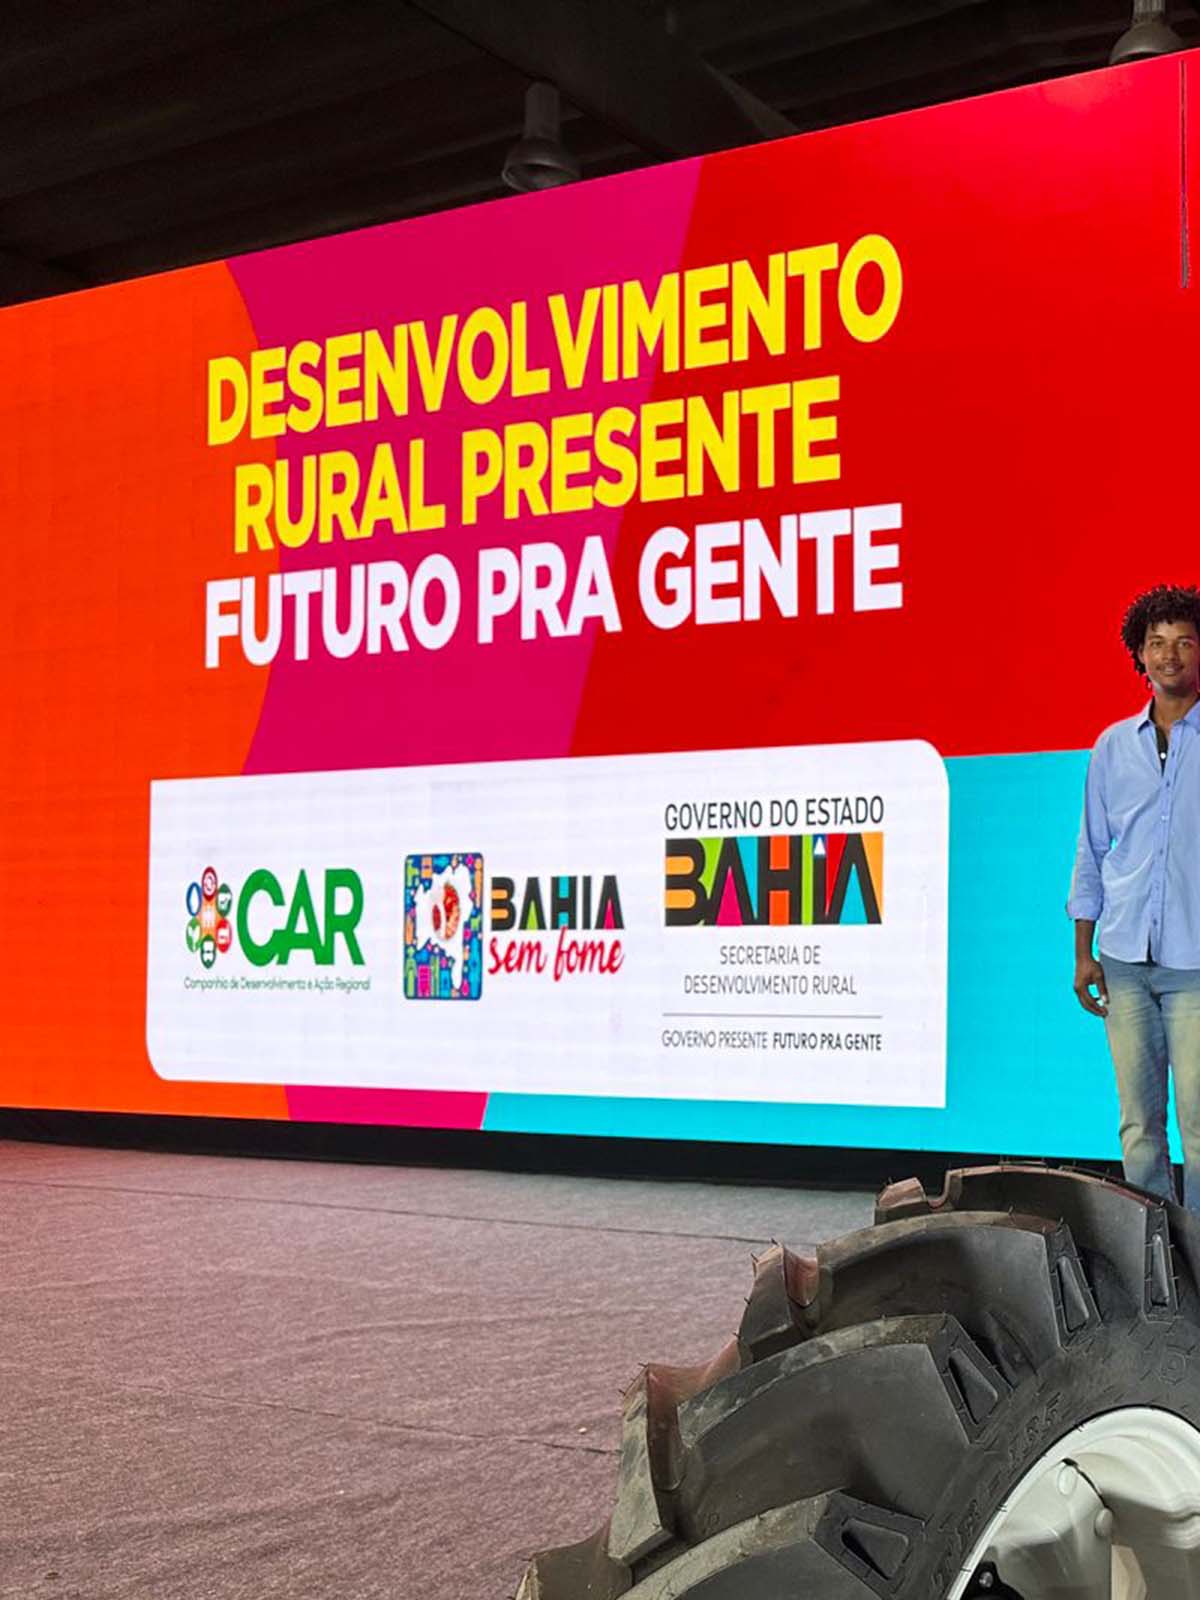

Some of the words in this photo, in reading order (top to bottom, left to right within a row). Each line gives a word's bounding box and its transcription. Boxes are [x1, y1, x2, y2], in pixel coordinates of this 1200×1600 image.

[207, 234, 903, 446] DESENVOLVIMENTO
[234, 439, 446, 553] RURAL
[462, 375, 841, 525] PRESENTE
[205, 553, 461, 669] FUTURO
[478, 535, 622, 644] PRA
[638, 503, 903, 629] GENTE
[664, 800, 763, 832] GOVERNO
[769, 799, 799, 827] DO
[805, 795, 885, 826] ESTADO
[490, 875, 625, 931] BAHIA
[665, 831, 884, 927] BAHIA
[236, 868, 366, 967] CAR
[488, 936, 547, 975] sem
[552, 926, 624, 982] fome
[719, 945, 800, 966] SECRETARIA
[803, 945, 821, 966] DE
[684, 974, 809, 995] DESENVOLVIMENTO
[812, 975, 858, 996] RURAL
[661, 1029, 717, 1048] GOVERNO
[718, 1030, 768, 1050] PRESENTE
[772, 1031, 819, 1050] FUTURO
[819, 1032, 842, 1051] PRA
[844, 1033, 883, 1052] GENTE
